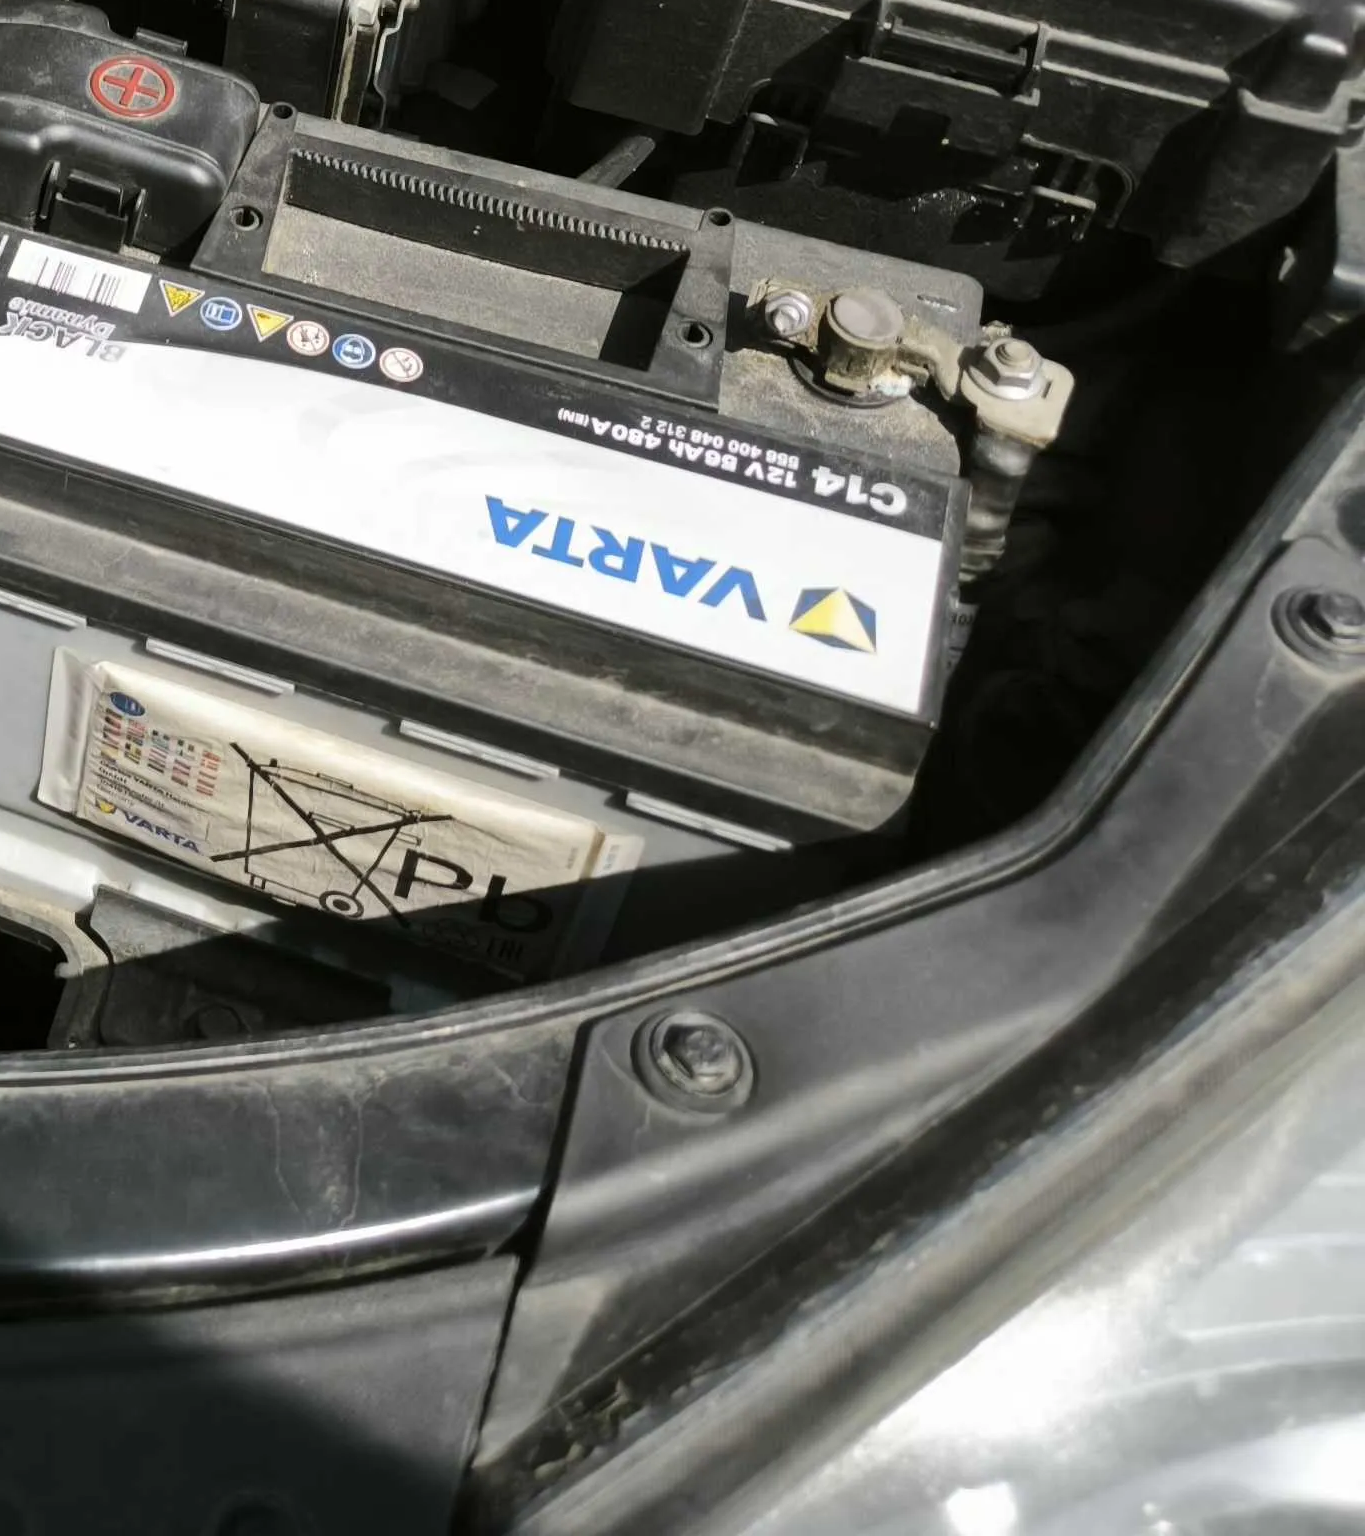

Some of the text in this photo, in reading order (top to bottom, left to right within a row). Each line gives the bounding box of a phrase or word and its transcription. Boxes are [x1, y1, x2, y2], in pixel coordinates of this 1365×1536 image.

[7, 296, 117, 341] Dynamic
[656, 419, 688, 440] 312
[689, 428, 725, 449] 048
[728, 439, 763, 459] 400
[668, 439, 738, 473] 56Ah
[744, 461, 798, 489] 12V
[811, 465, 908, 515] C14
[485, 494, 768, 622] VARTA
[123, 810, 201, 855] VARTA
[394, 848, 553, 933] Pb
